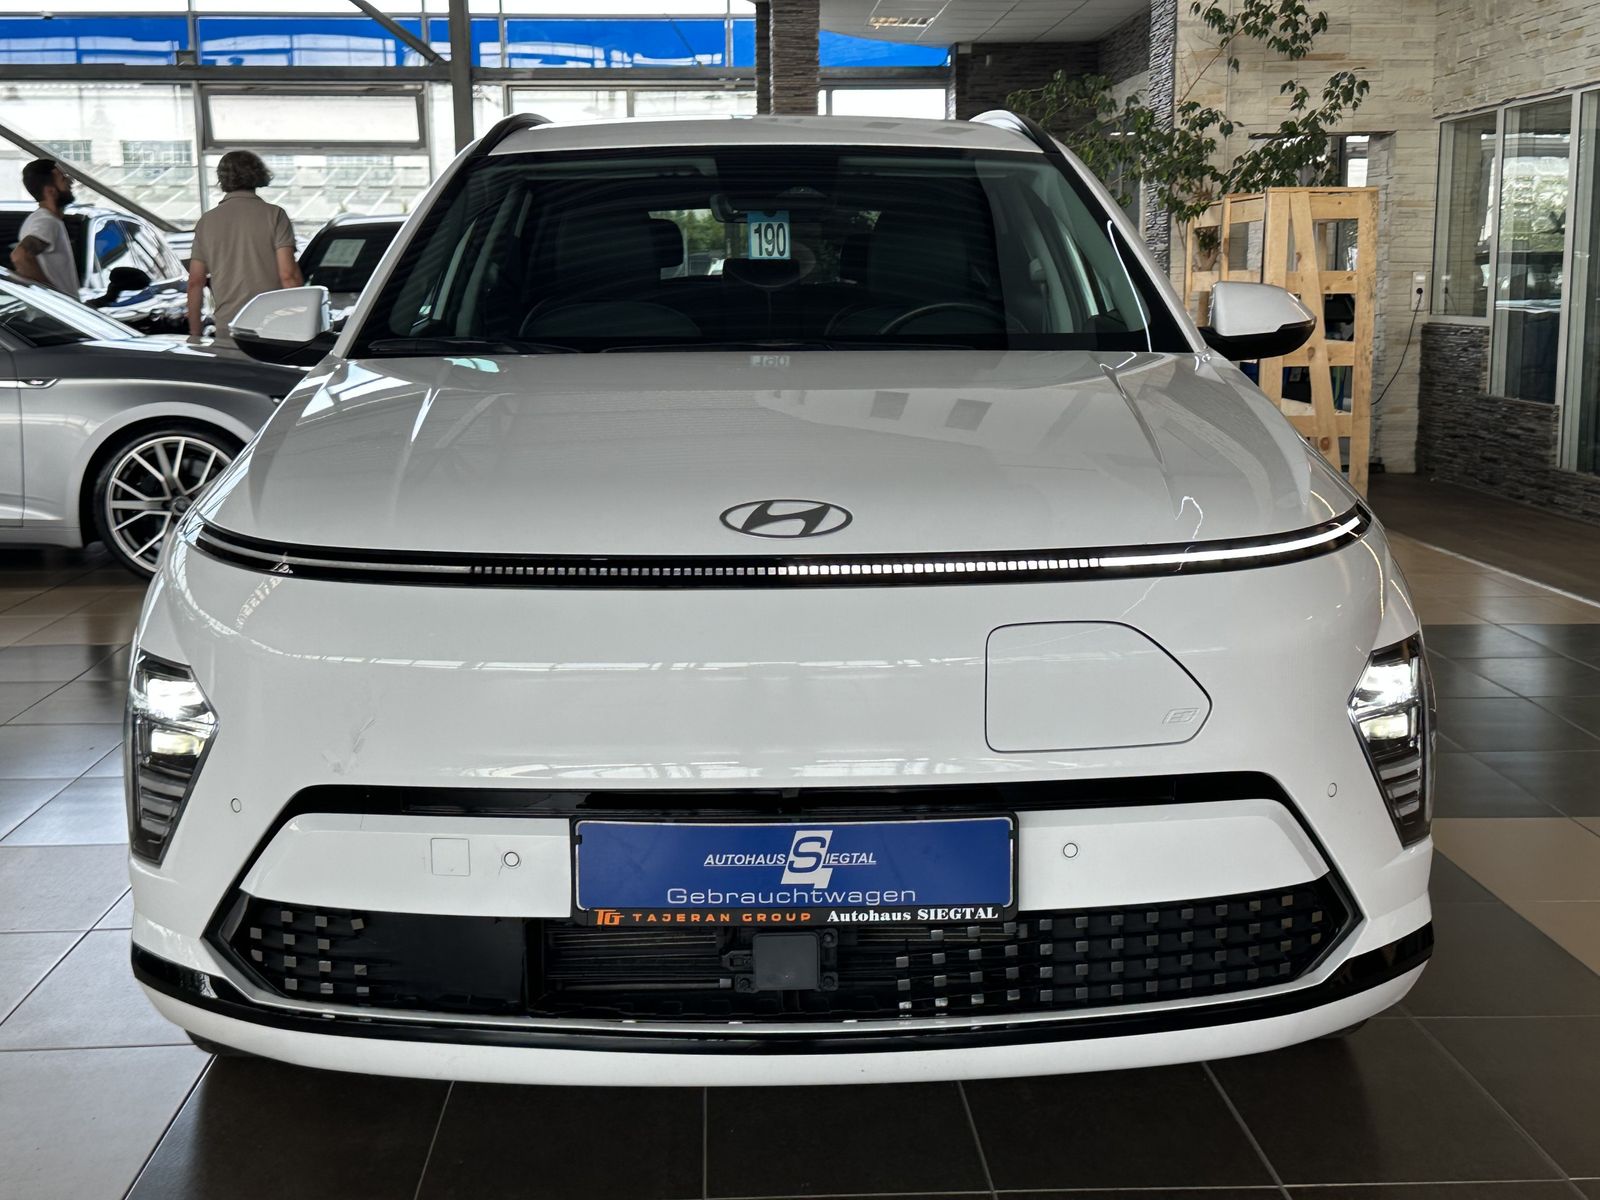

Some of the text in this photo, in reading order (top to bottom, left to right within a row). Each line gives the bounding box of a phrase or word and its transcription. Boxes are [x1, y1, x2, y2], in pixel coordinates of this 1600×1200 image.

[754, 222, 786, 257] 190
[704, 853, 787, 866] AUTOHAUS
[667, 887, 916, 905] Gebrauchtwagen
[632, 913, 730, 922] TAJERAN
[742, 912, 811, 922] GROUP
[827, 907, 999, 922] Autohaus SIEGTAL
